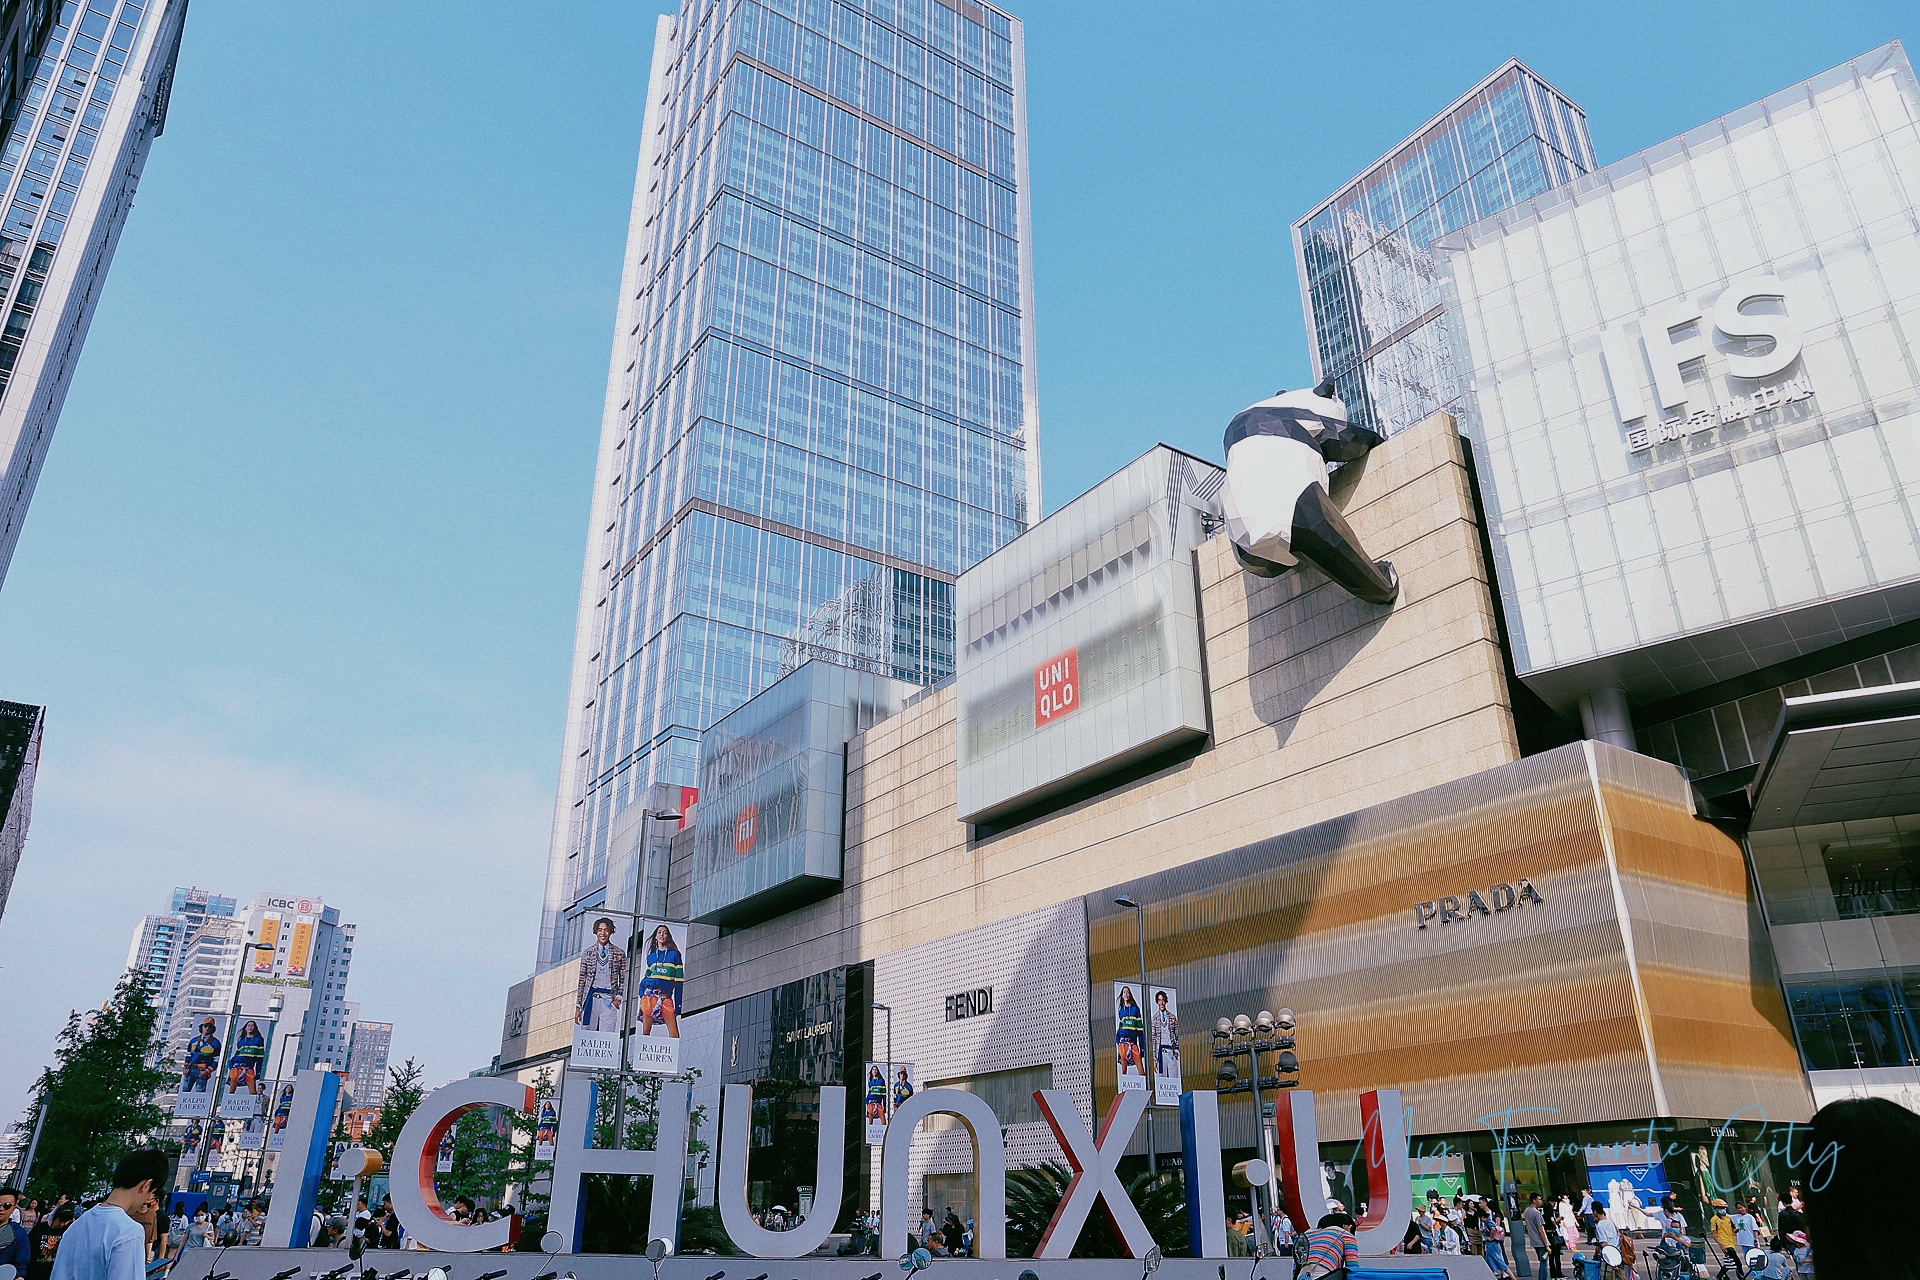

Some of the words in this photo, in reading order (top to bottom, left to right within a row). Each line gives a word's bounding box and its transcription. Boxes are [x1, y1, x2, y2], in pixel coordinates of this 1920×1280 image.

[1600, 273, 1803, 424] IFS
[1626, 379, 1815, 454] 国际金融中心
[1039, 657, 1070, 691] UNI
[1040, 683, 1074, 719] QLO
[267, 898, 295, 909] ICBC
[1414, 877, 1545, 931] PRADA
[945, 986, 993, 1023] FENDI
[580, 1039, 611, 1049] RALPH
[642, 1044, 671, 1054] RALPH
[577, 1048, 614, 1059] LAUREN
[639, 1053, 673, 1064] LAUREN
[1122, 1081, 1142, 1089] RALPH
[1159, 1083, 1178, 1092] RALPH
[1158, 1090, 1179, 1098] LAUREN
[182, 1097, 206, 1105] RALPH
[227, 1099, 250, 1107] RALPH
[179, 1103, 207, 1111] LAUREN
[1499, 1133, 1541, 1147] PRADA
[1161, 1157, 1183, 1167] PRAD
